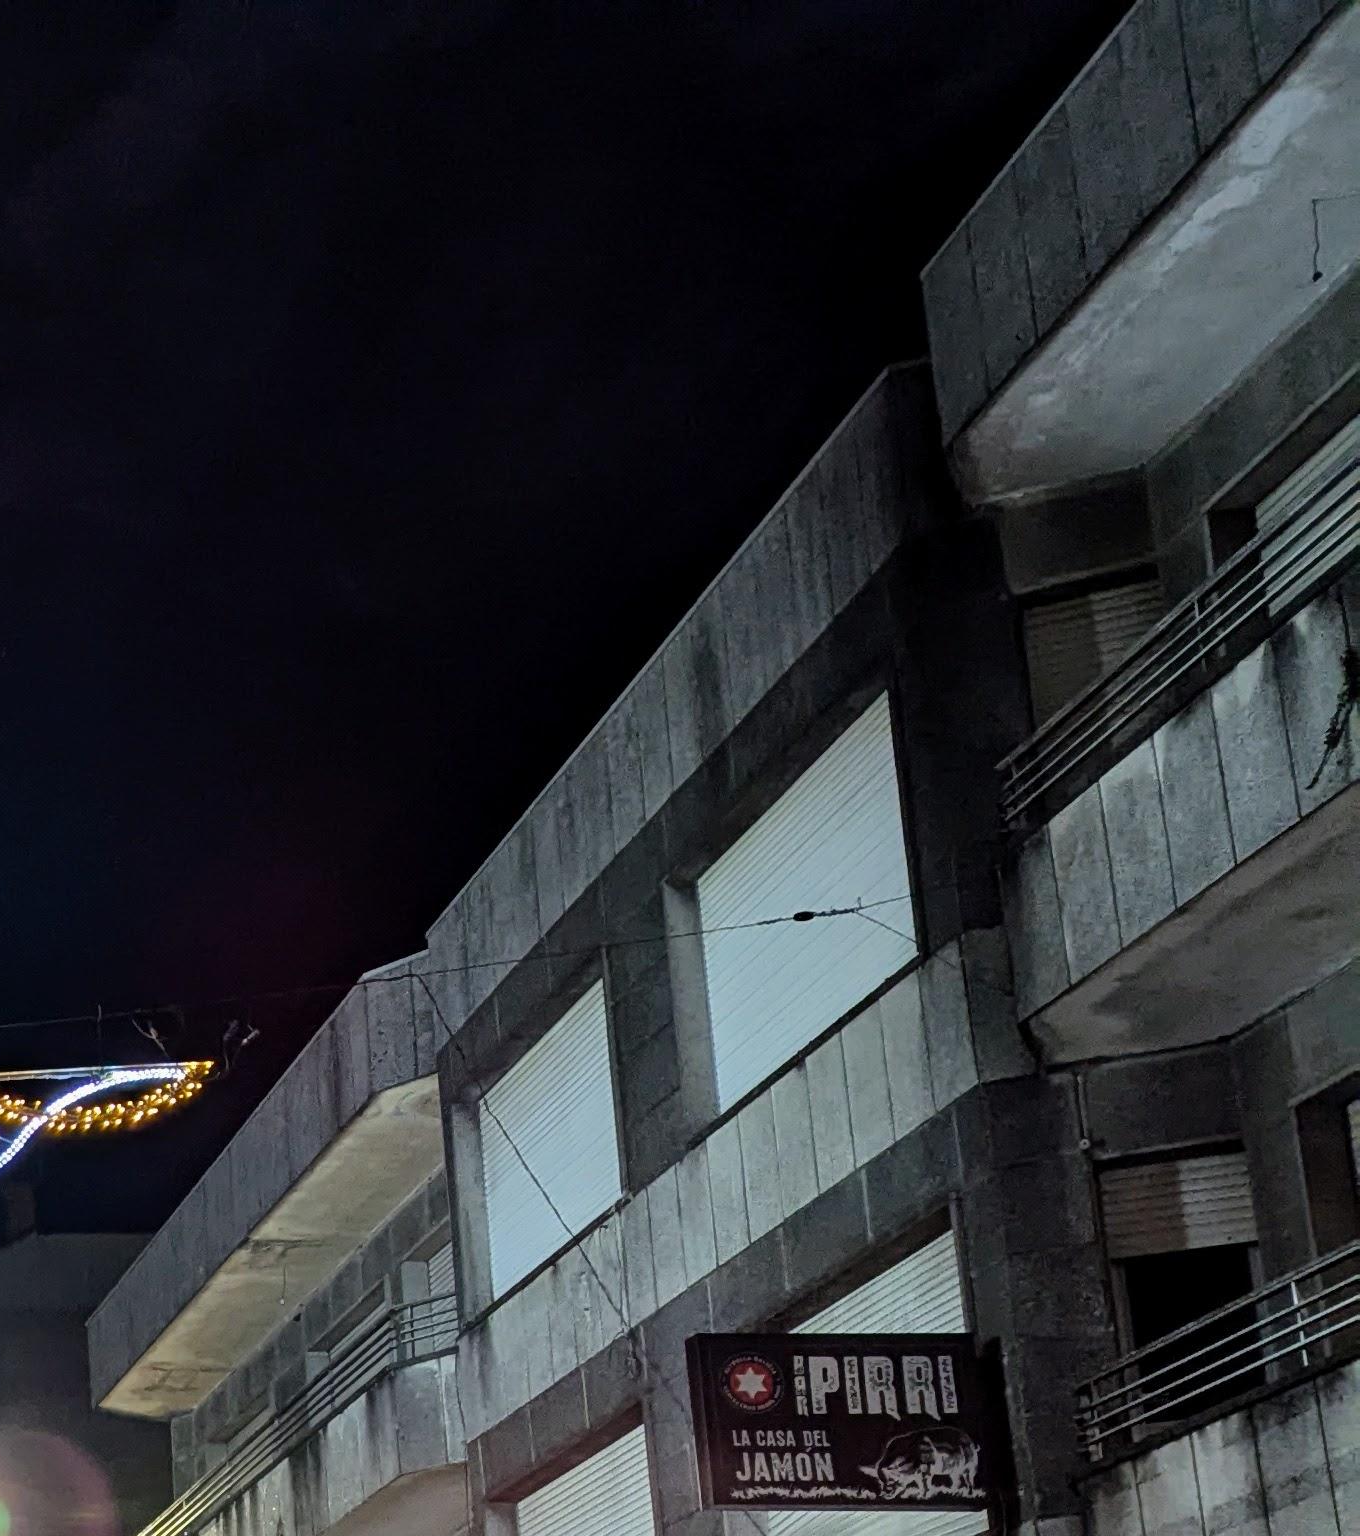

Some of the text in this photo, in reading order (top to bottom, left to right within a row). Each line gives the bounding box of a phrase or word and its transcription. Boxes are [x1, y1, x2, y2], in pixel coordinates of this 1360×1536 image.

[732, 1430, 831, 1447] LA CASA DEL
[736, 1447, 835, 1482] JAMÓN
